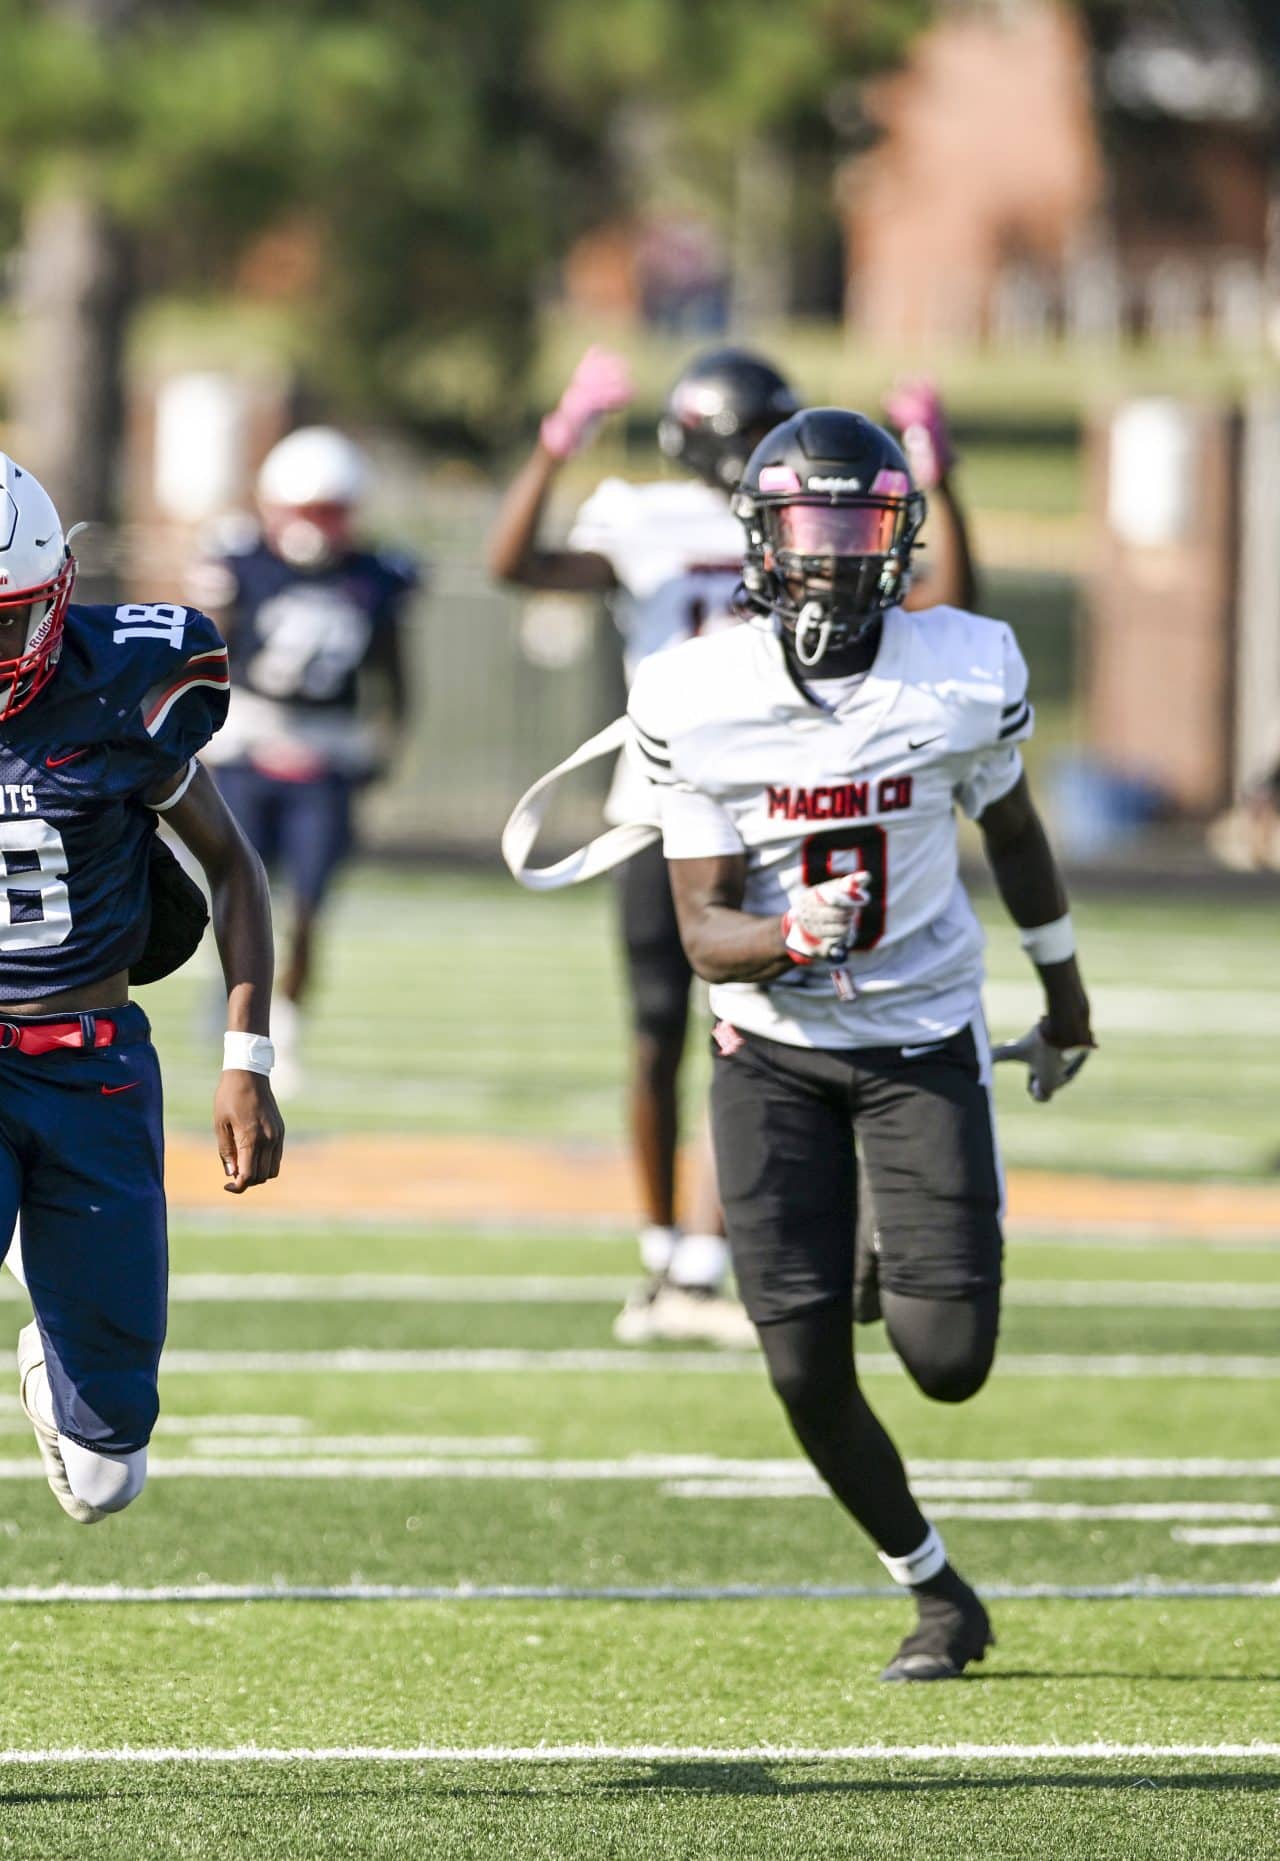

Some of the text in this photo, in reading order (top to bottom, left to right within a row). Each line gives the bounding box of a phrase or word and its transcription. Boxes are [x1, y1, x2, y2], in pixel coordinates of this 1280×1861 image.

[113, 604, 187, 650] 18
[766, 774, 913, 820] MACON CO
[802, 823, 888, 955] 9
